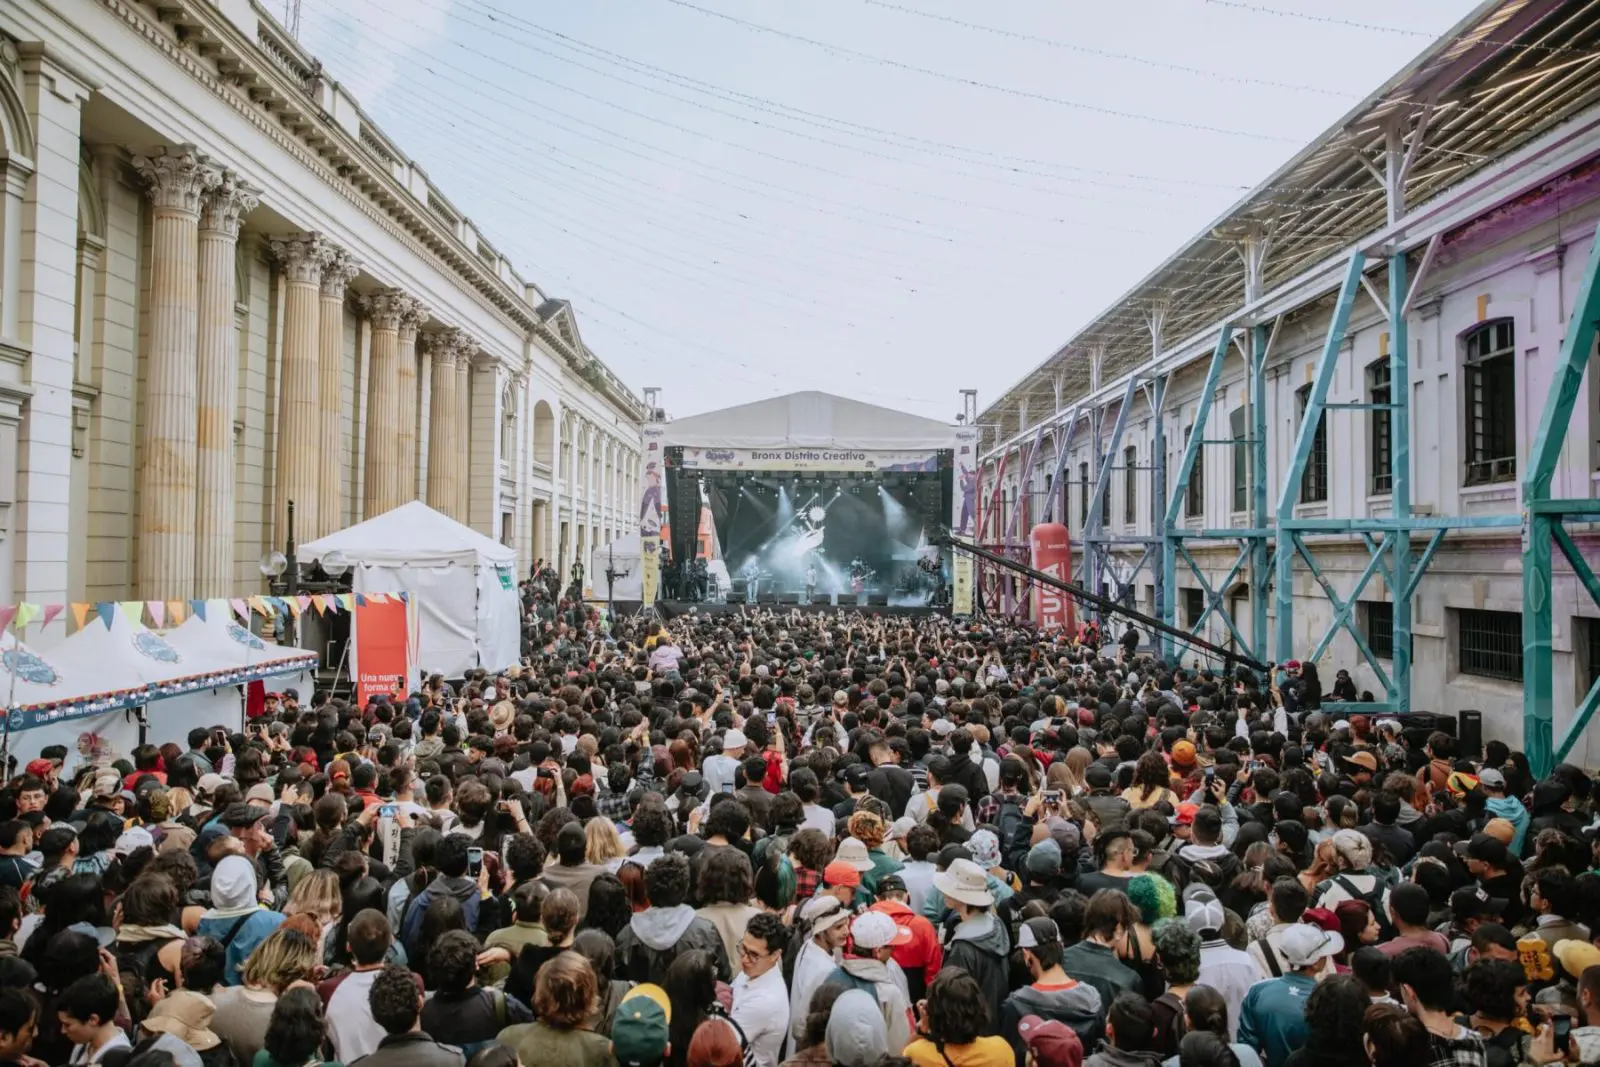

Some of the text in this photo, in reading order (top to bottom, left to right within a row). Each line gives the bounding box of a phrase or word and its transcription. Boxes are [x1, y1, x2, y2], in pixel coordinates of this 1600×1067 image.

[752, 451, 782, 460] Bronx
[785, 451, 820, 460] Distrito
[822, 451, 865, 460] Creativo
[361, 673, 377, 682] Una
[364, 682, 389, 692] forma
